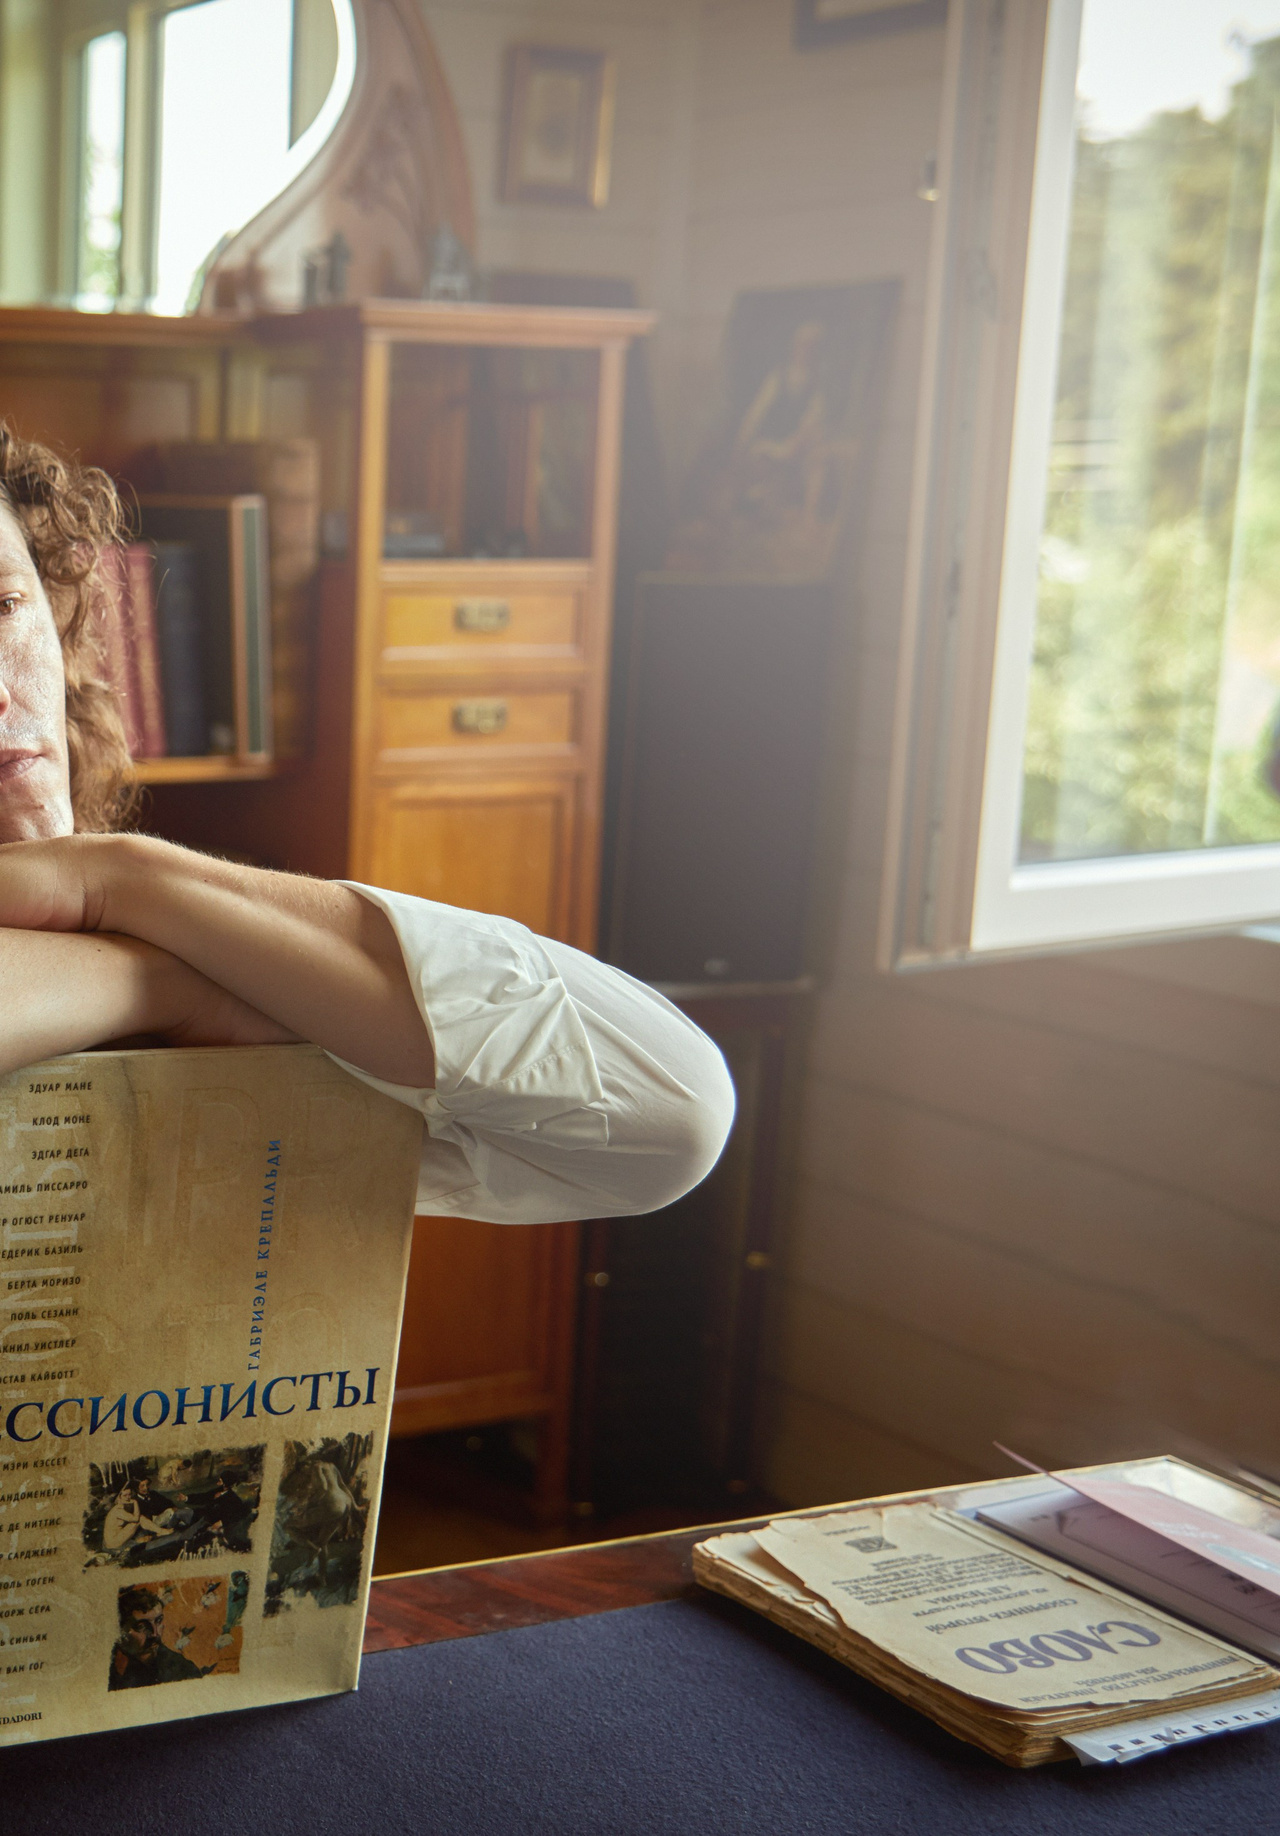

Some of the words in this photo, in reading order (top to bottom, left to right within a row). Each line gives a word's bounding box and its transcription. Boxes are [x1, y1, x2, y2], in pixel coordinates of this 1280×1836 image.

[28, 1082, 61, 1095] ЭДУАР
[63, 1080, 93, 1092] МАНЕ
[31, 1115, 60, 1127] КЛОД
[62, 1114, 92, 1125] МОНЕ
[31, 1148, 63, 1161] ЭДГАР
[65, 1147, 90, 1160] ДЕГА
[35, 1179, 89, 1193] ПИССАРРО
[257, 1138, 281, 1260] КРЕПАЛЬДИ
[11, 1215, 45, 1227] ОГЮСТ
[47, 1212, 86, 1224] РЕНУАР
[44, 1244, 84, 1256] БАЗИЛЬ
[6, 1277, 39, 1292] БЕРТА
[40, 1275, 81, 1288] МОРИЗО
[9, 1310, 38, 1322] ПОЛЬ
[40, 1307, 80, 1320] СЕЗАНН
[247, 1270, 268, 1371] ГАБРИЭЛЕ
[33, 1336, 77, 1352] УИСТЛЕР
[29, 1368, 76, 1383] КАЙБОТТ
[1, 1460, 29, 1472] МЭРИ
[32, 1455, 69, 1471] КЭССЕТ
[7, 1522, 21, 1534] ДЕ
[23, 1516, 63, 1530] НИТТИС
[7, 1546, 59, 1561] САРДЖЕНТ
[25, 1575, 55, 1588] ГОГЕН
[9, 1632, 48, 1646] СИНЬЯК
[955, 1620, 1161, 1675] СЛОВО
[5, 1664, 26, 1675] ВАН
[28, 1661, 44, 1672] ГОГ
